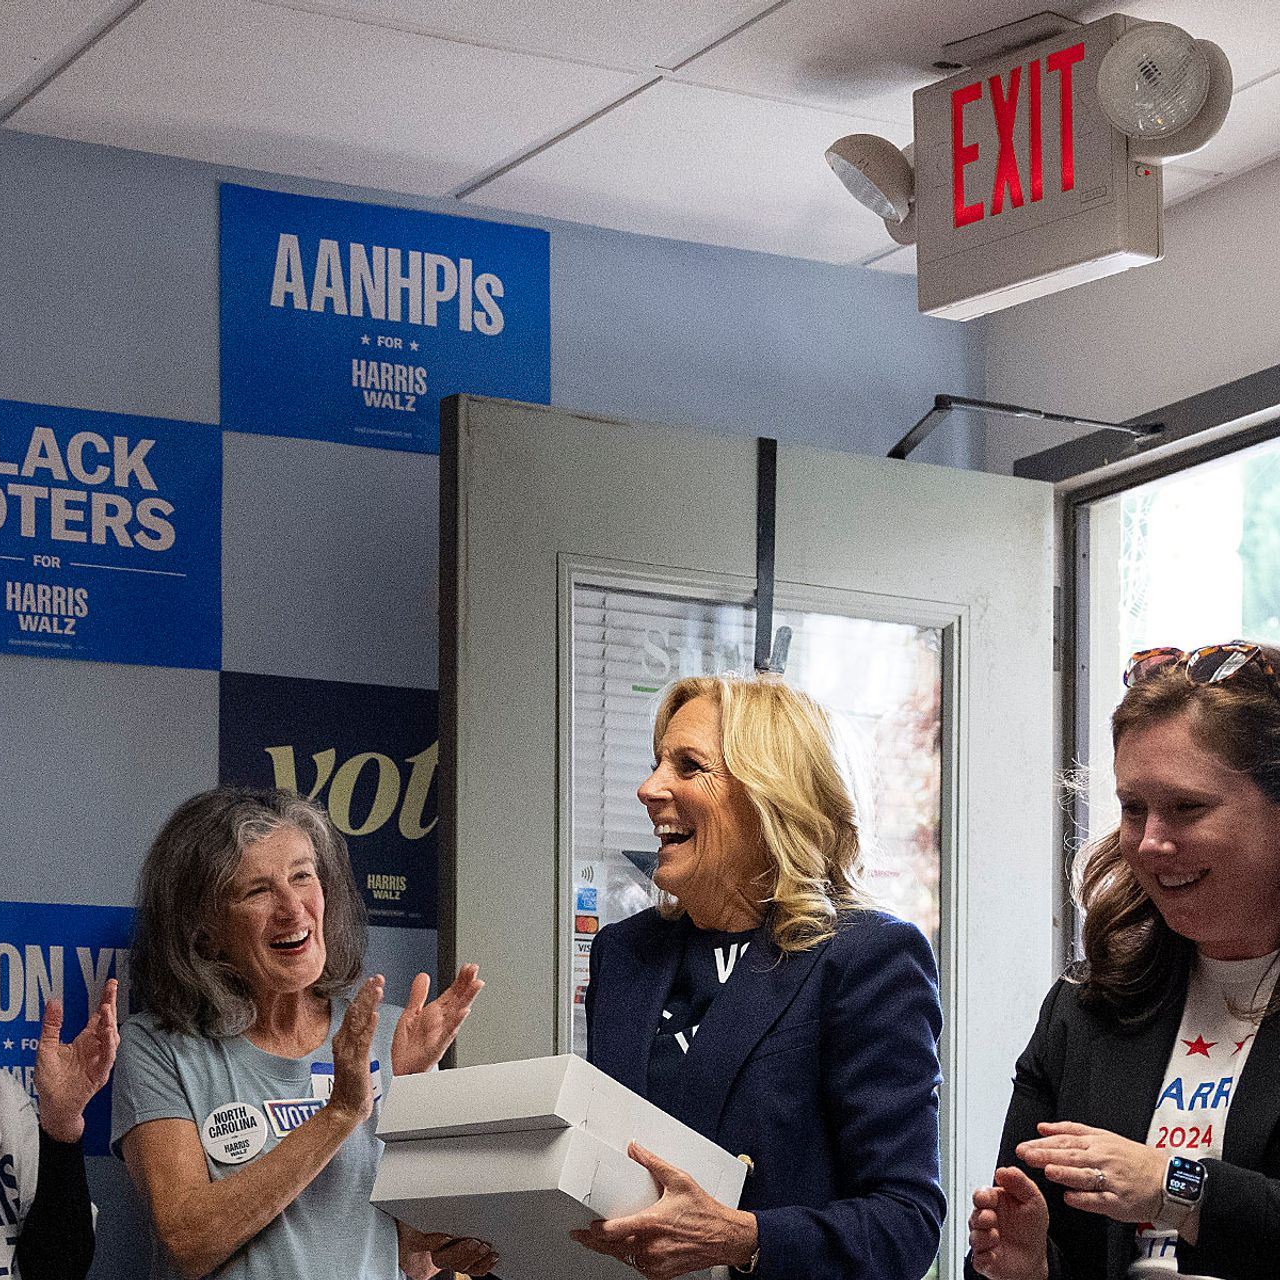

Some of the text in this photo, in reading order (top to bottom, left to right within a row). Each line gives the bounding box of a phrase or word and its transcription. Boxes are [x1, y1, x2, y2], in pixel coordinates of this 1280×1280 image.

[951, 42, 1085, 229] EXIT
[377, 335, 402, 350] FOR
[352, 359, 427, 396] HARRIS
[363, 390, 416, 412] WALZ
[33, 554, 61, 569] FOR
[6, 580, 89, 618] HARRIS
[19, 614, 76, 636] WALZ
[367, 874, 407, 891] HARRIS
[372, 890, 401, 900] WALZ
[208, 1115, 258, 1138] CAROLINA
[213, 1106, 247, 1125] NORTH
[224, 1138, 250, 1153] HARRIS
[1155, 1124, 1213, 1149] 2024
